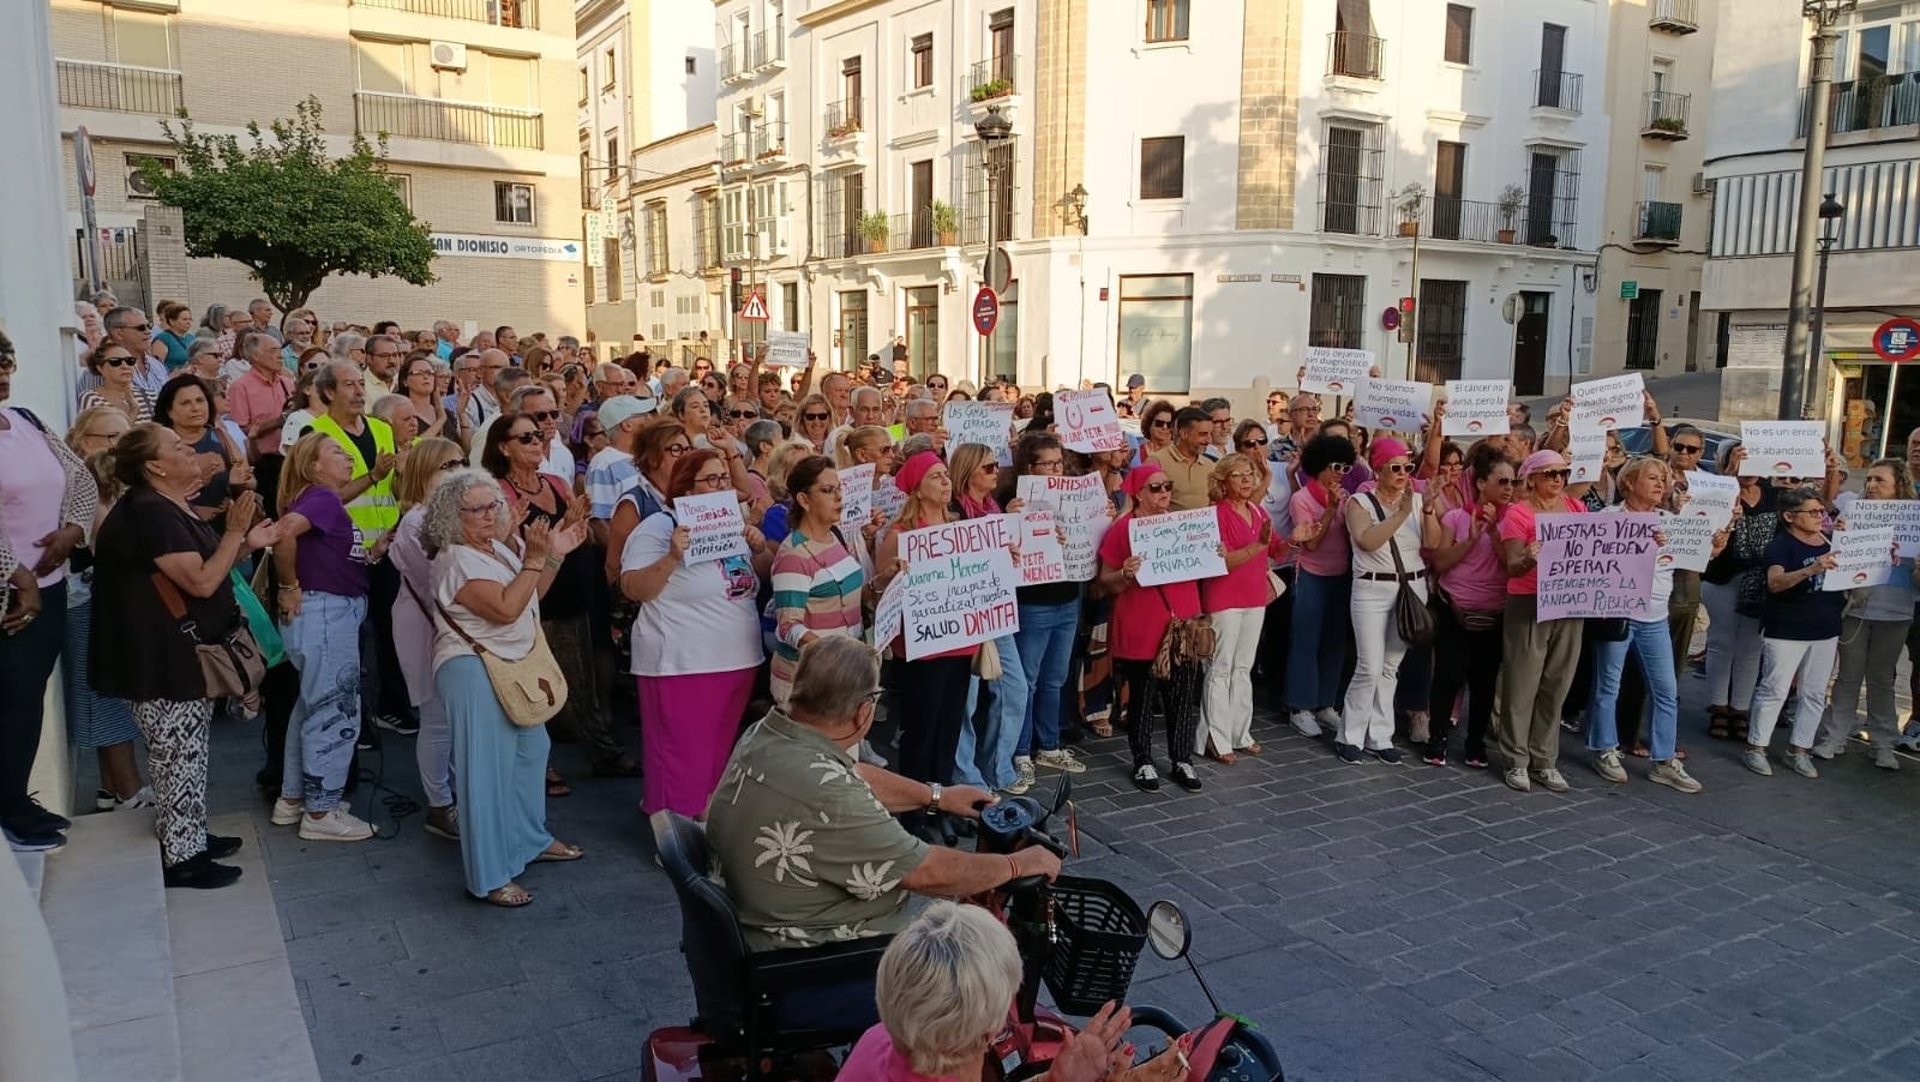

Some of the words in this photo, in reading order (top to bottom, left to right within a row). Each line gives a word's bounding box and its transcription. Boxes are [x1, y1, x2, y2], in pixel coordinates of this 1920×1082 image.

[430, 238, 451, 250] SAN
[457, 240, 509, 253] DIONISIO
[514, 244, 562, 254] ORTOPEDIA
[1313, 349, 1330, 357] Nos
[1332, 350, 1366, 359] dejaron
[1312, 365, 1348, 374] Nosotras
[1369, 382, 1382, 390] No
[1384, 384, 1416, 393] somos
[1455, 384, 1463, 392] El
[1493, 384, 1504, 392] no
[1577, 381, 1622, 397] Queremos
[1476, 398, 1494, 407] pero
[1496, 396, 1504, 405] la
[1609, 391, 1634, 404] digno
[1361, 405, 1389, 415] somos
[1744, 427, 1760, 436] No
[1762, 428, 1774, 436] es
[1776, 428, 1790, 436] un
[1749, 447, 1761, 455] es
[1855, 501, 1879, 511] Nos
[1670, 518, 1710, 527] dejaron
[1844, 512, 1861, 520] sin
[1540, 522, 1607, 542] NUESTRAS
[1841, 533, 1880, 546] Queremos
[1563, 540, 1584, 559] NO
[1592, 539, 1650, 557] PUEDEN
[903, 569, 946, 589] Juanma
[949, 556, 991, 581] Moreno
[1151, 557, 1203, 575] PRIVADA
[1549, 559, 1622, 577] ESPERAR
[1619, 576, 1638, 590] LA
[1540, 591, 1588, 608] SANIDAD
[911, 595, 977, 625] garantizar
[914, 619, 960, 643] SALUD
[963, 601, 1016, 637] DIMITA
